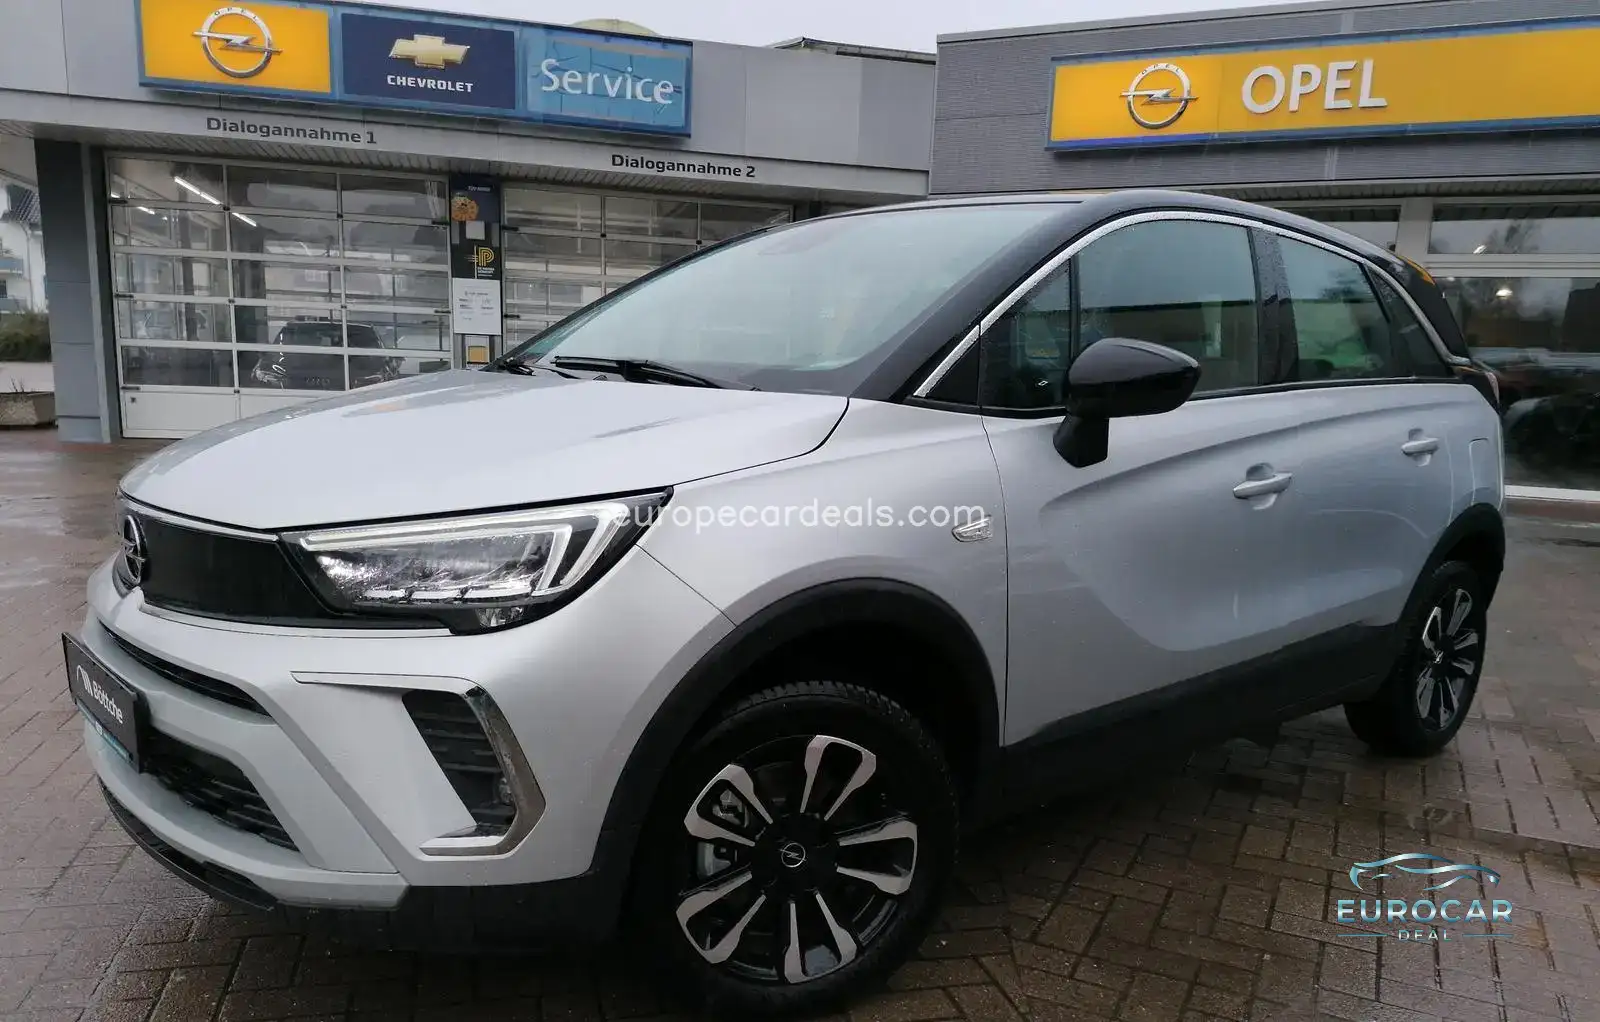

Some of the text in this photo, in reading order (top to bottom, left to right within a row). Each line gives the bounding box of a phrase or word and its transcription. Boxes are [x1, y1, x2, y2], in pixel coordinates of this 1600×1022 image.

[386, 74, 474, 93] CHEVROLET
[540, 58, 674, 105] Service
[1241, 59, 1388, 114] OPEL
[206, 117, 377, 144] Dialogannahme 1
[611, 154, 756, 178] Dialogannahme 2
